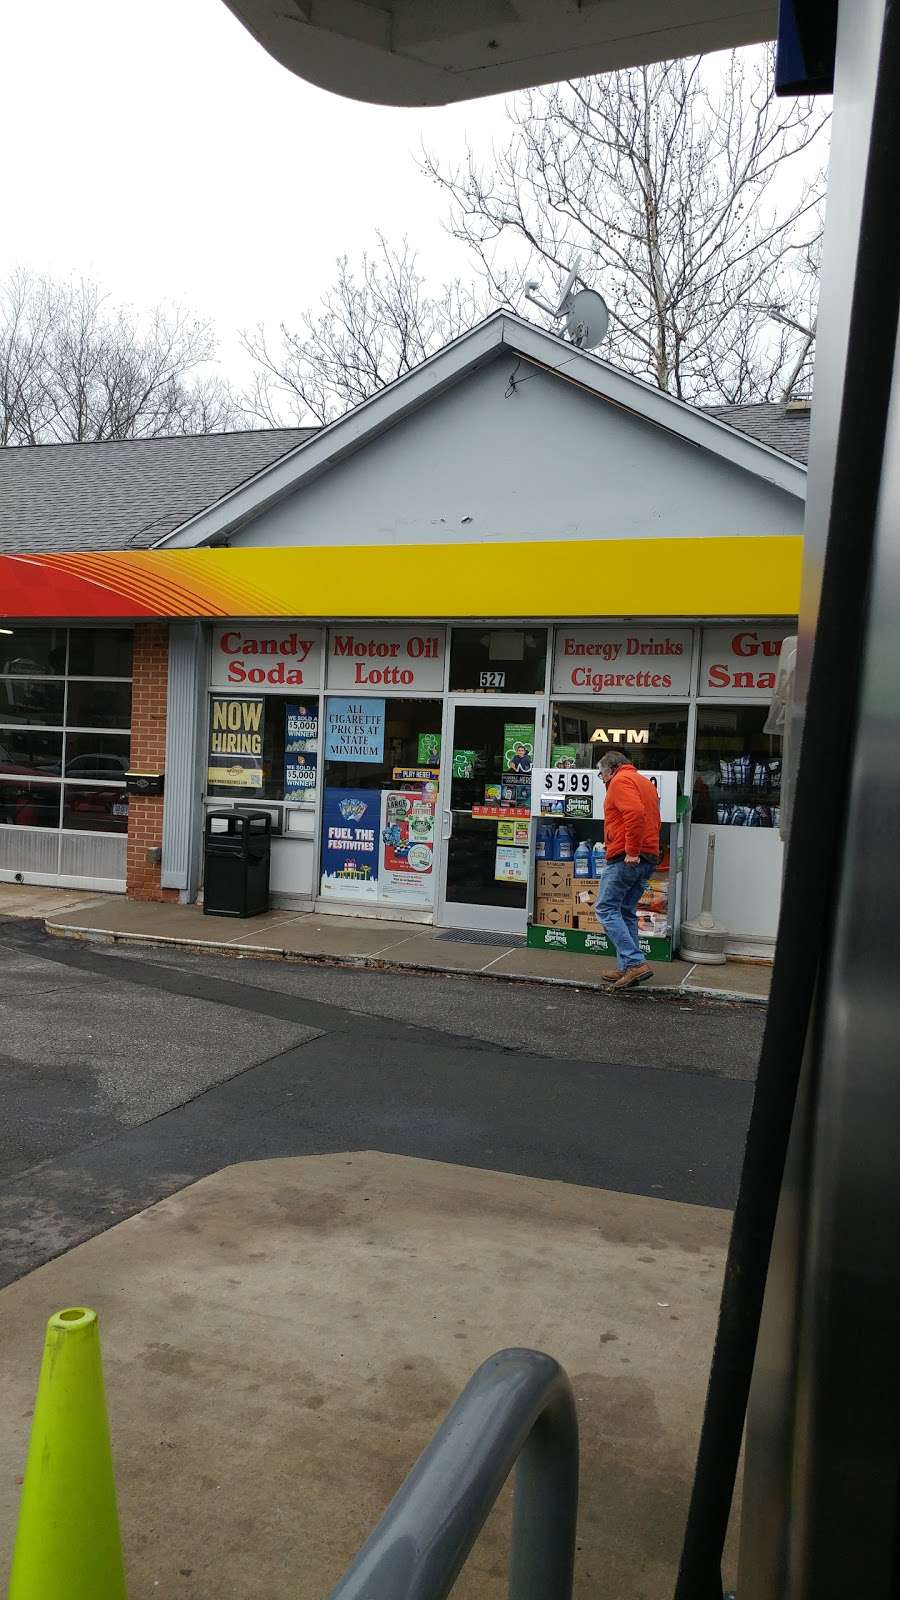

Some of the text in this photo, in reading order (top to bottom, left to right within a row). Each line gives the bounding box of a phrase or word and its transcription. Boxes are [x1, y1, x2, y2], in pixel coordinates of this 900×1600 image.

[220, 631, 314, 662] Candy
[333, 635, 439, 658] Motor Oil
[563, 638, 683, 660] Energy Drinks
[731, 632, 782, 657] Gu
[227, 660, 304, 685] Soda
[354, 662, 414, 685] Lotto
[480, 672, 505, 687] 527
[571, 667, 672, 692] Cigarettes
[213, 701, 263, 731] NOW
[347, 704, 364, 714] ALL
[288, 721, 316, 730] $5,000
[329, 714, 381, 725] CIGARETTE
[331, 724, 379, 735] PRICES AT
[589, 728, 649, 744] ATM
[212, 732, 262, 754] HIRING
[340, 735, 369, 746] STATE
[330, 745, 378, 756] MINIMUM
[287, 771, 314, 780] $5,000
[566, 804, 590, 813] Spring
[328, 827, 375, 841] FUEL THE
[328, 840, 374, 852] FESTIVITIES
[544, 934, 567, 945] Spring
[585, 939, 609, 949] Spring
